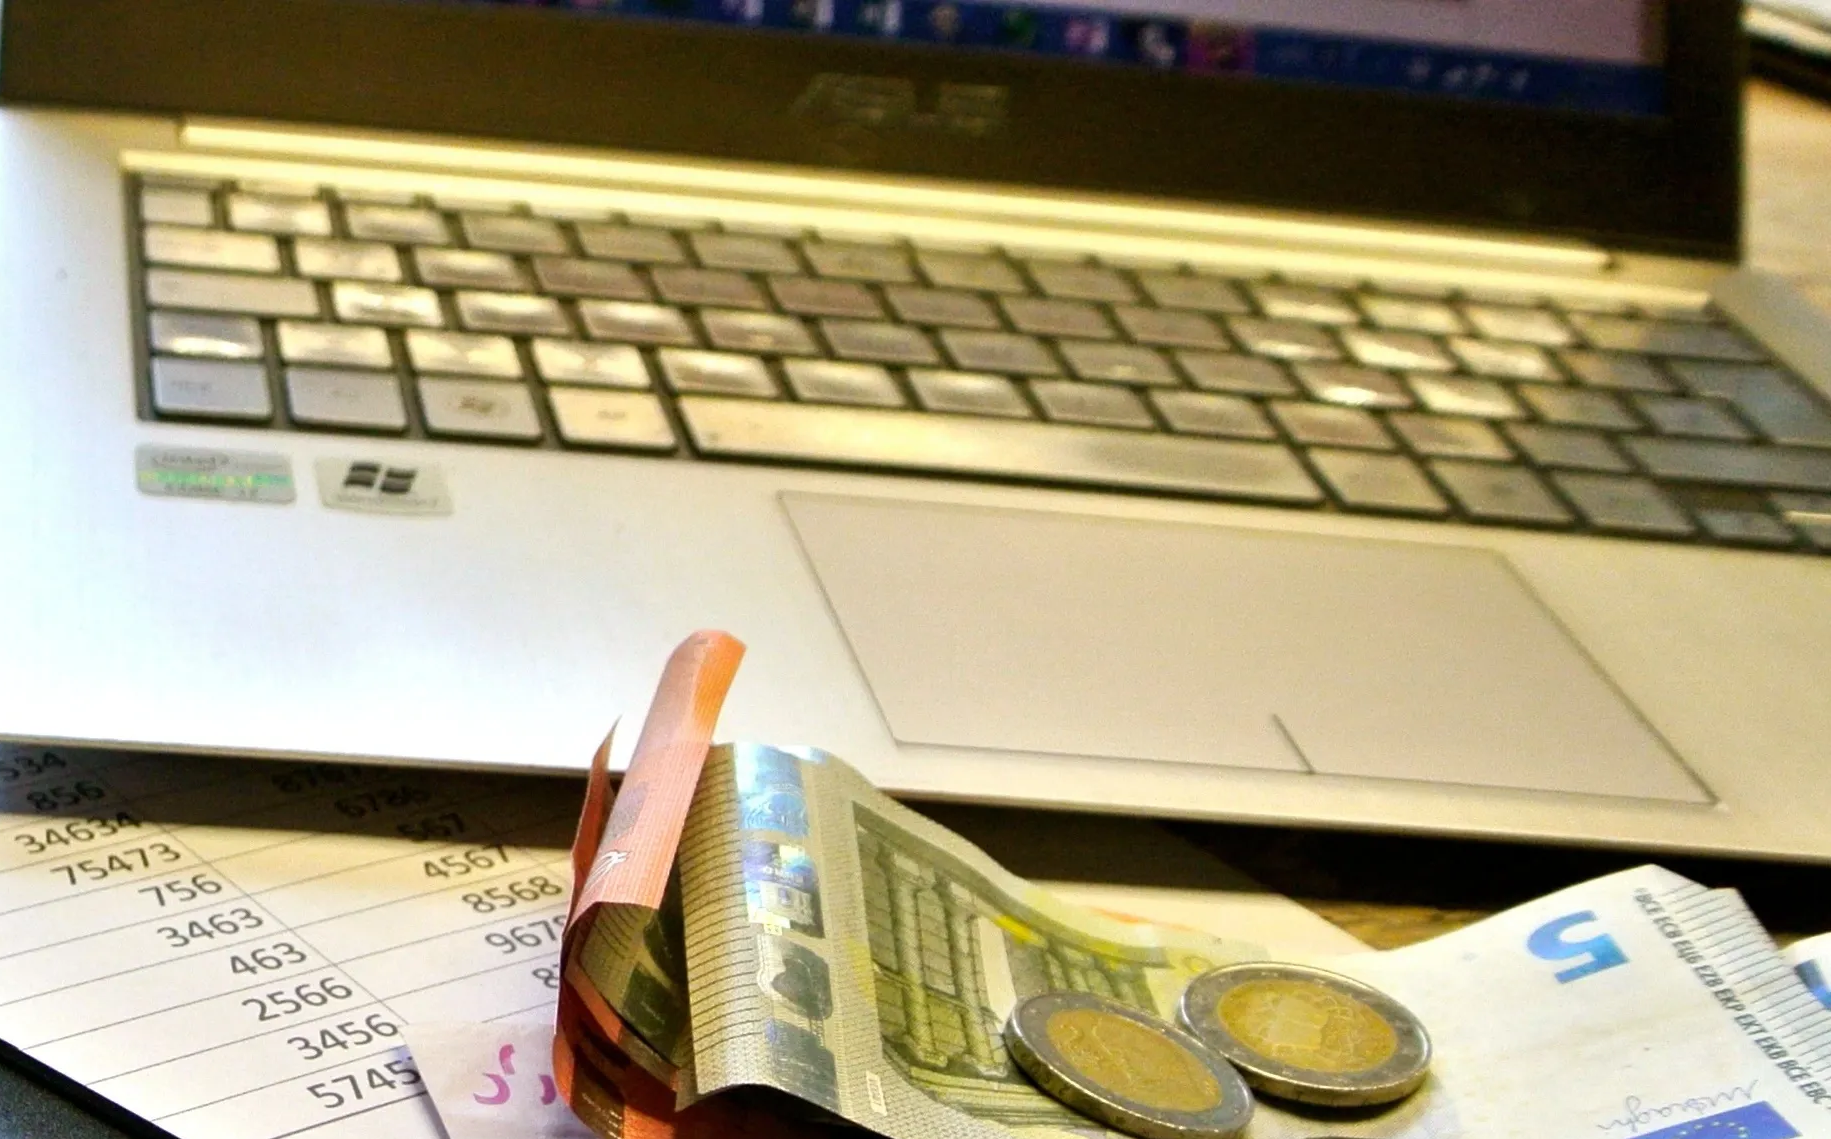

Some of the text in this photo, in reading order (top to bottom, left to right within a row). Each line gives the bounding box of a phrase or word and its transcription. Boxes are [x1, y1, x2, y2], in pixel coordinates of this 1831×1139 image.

[26, 779, 105, 812] 856
[15, 810, 143, 854] 34634
[49, 842, 182, 887] 75473
[422, 844, 512, 880] 4567
[137, 872, 223, 908] 756
[461, 875, 564, 914] 8568
[156, 907, 266, 948] 3463
[229, 942, 308, 976] 463
[241, 976, 354, 1022] 2566
[287, 1013, 400, 1061] 3456
